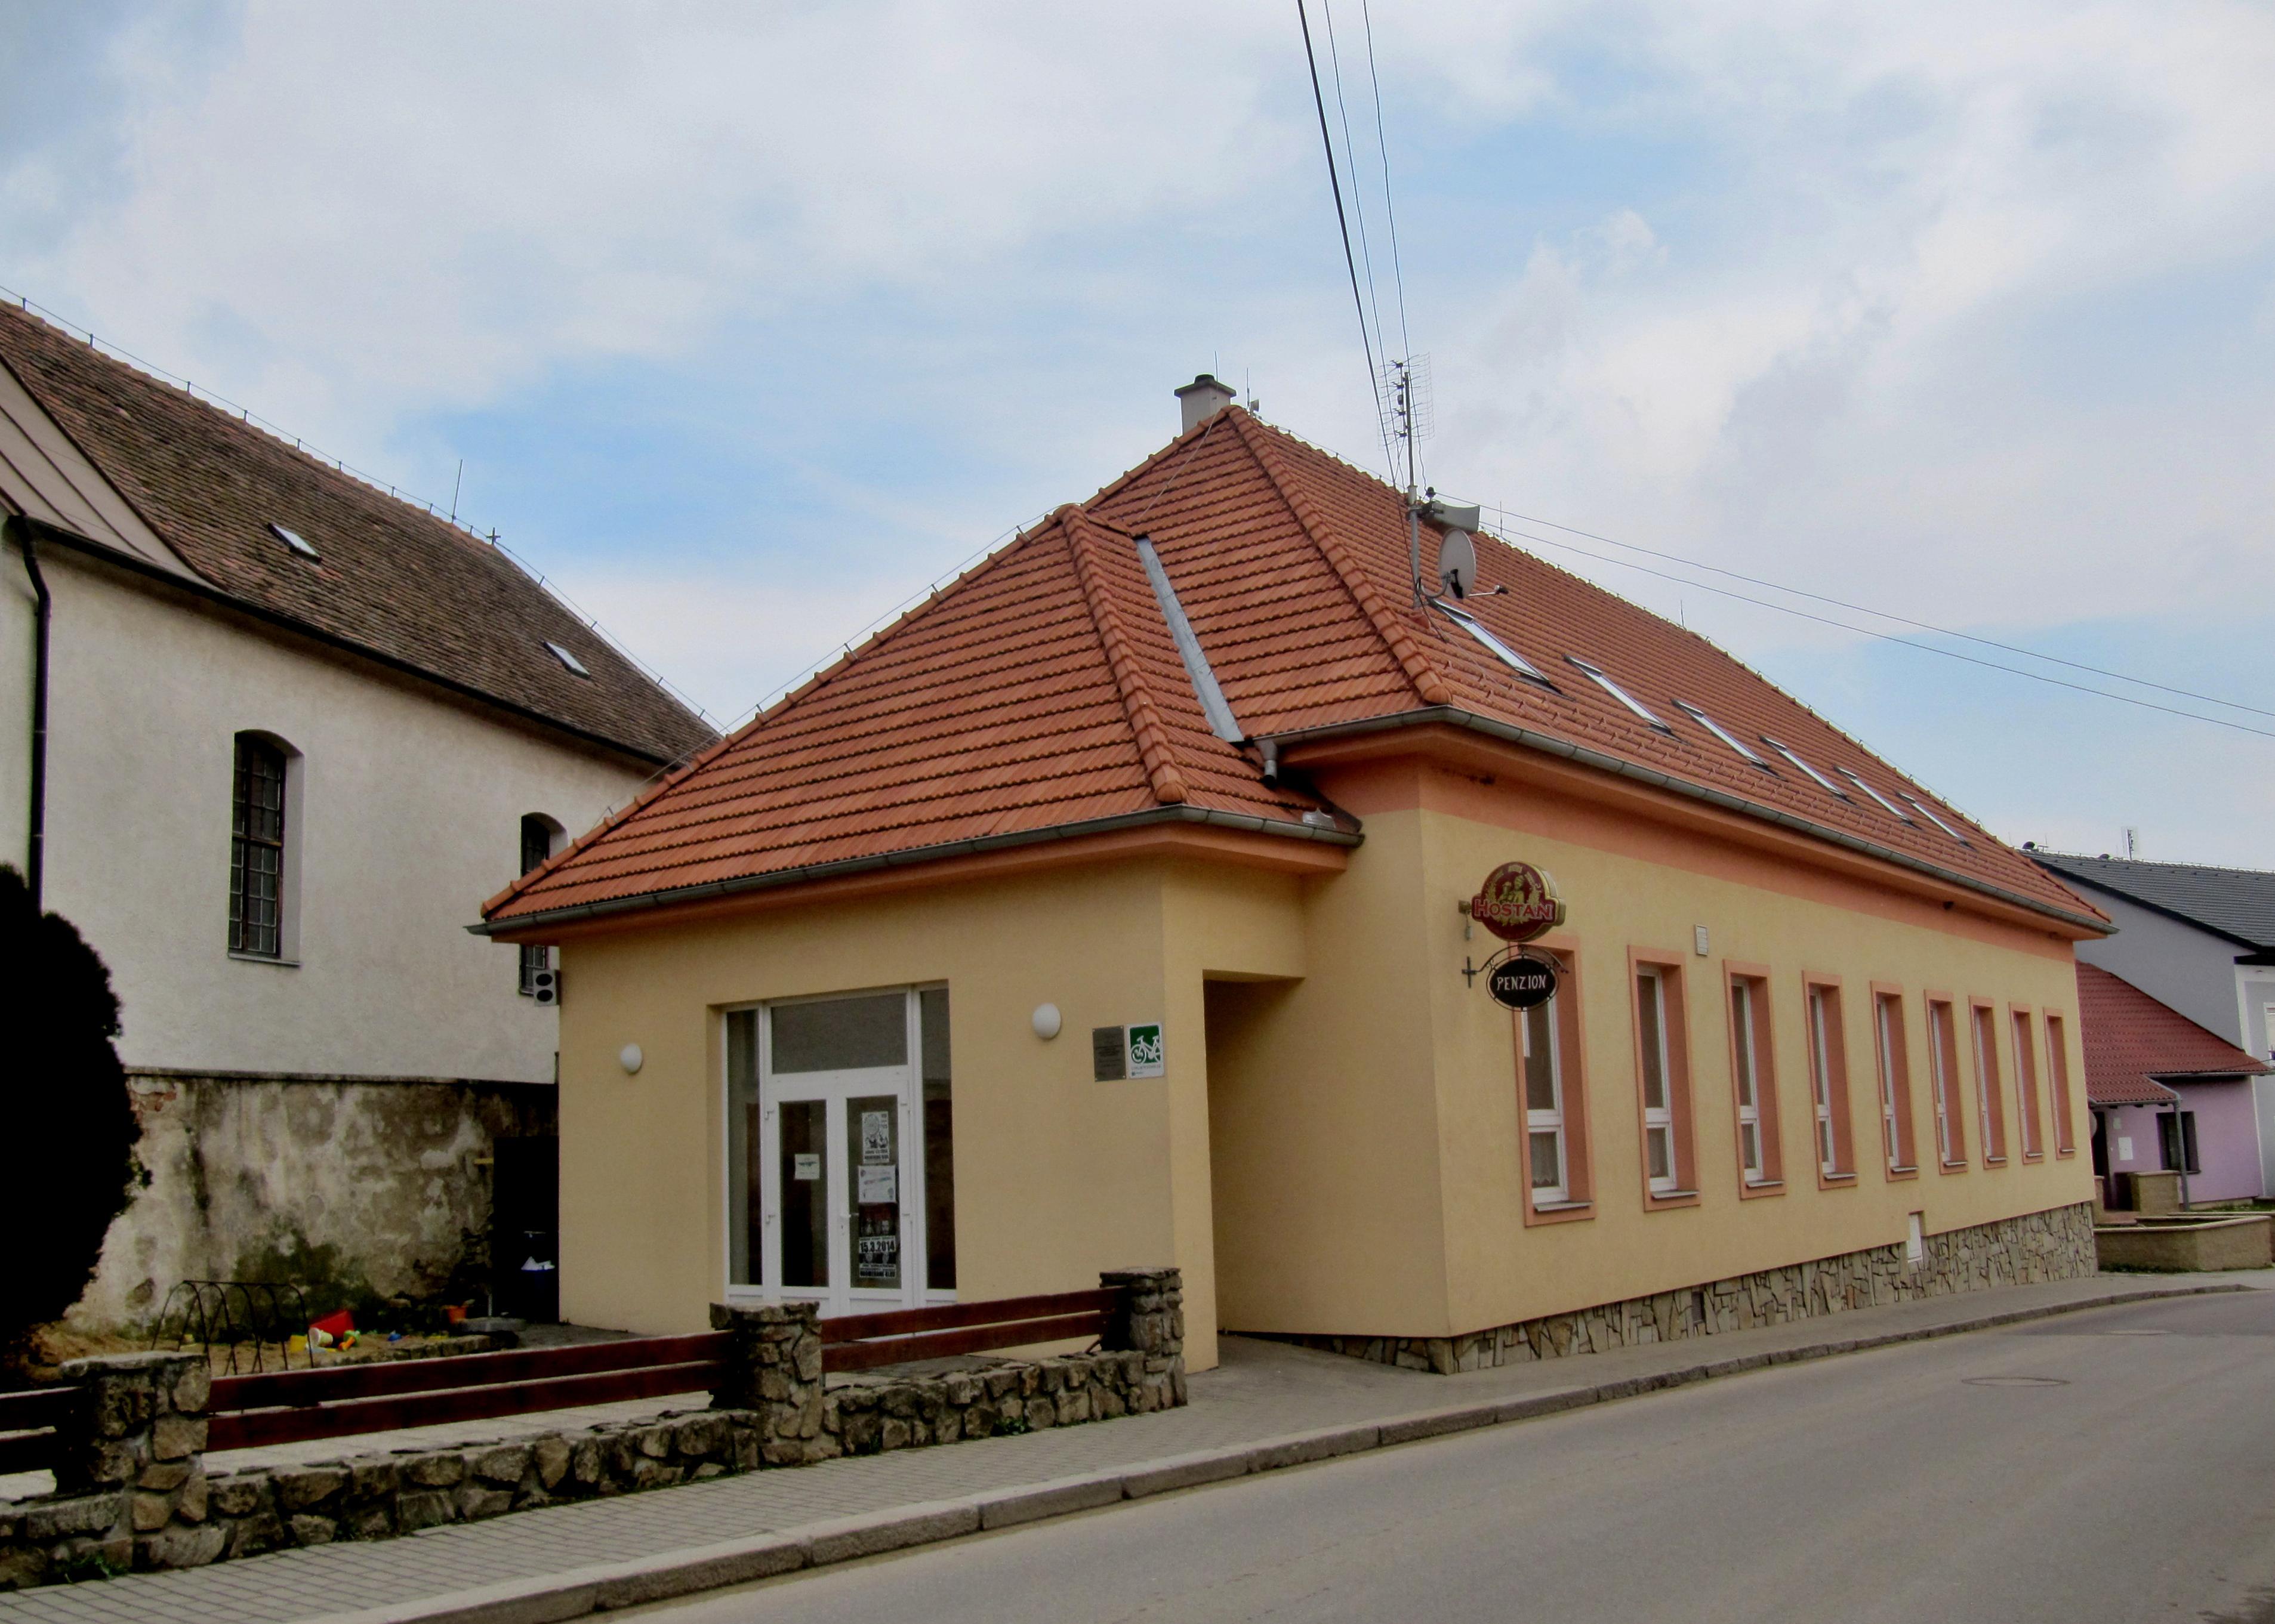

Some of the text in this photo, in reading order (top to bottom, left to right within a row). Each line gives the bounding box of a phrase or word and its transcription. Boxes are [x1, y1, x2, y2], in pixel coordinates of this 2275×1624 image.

[1475, 899, 1553, 920] HOSTAN
[1497, 975, 1546, 990] PENZION
[860, 1240, 895, 1252] 15.3.2014
